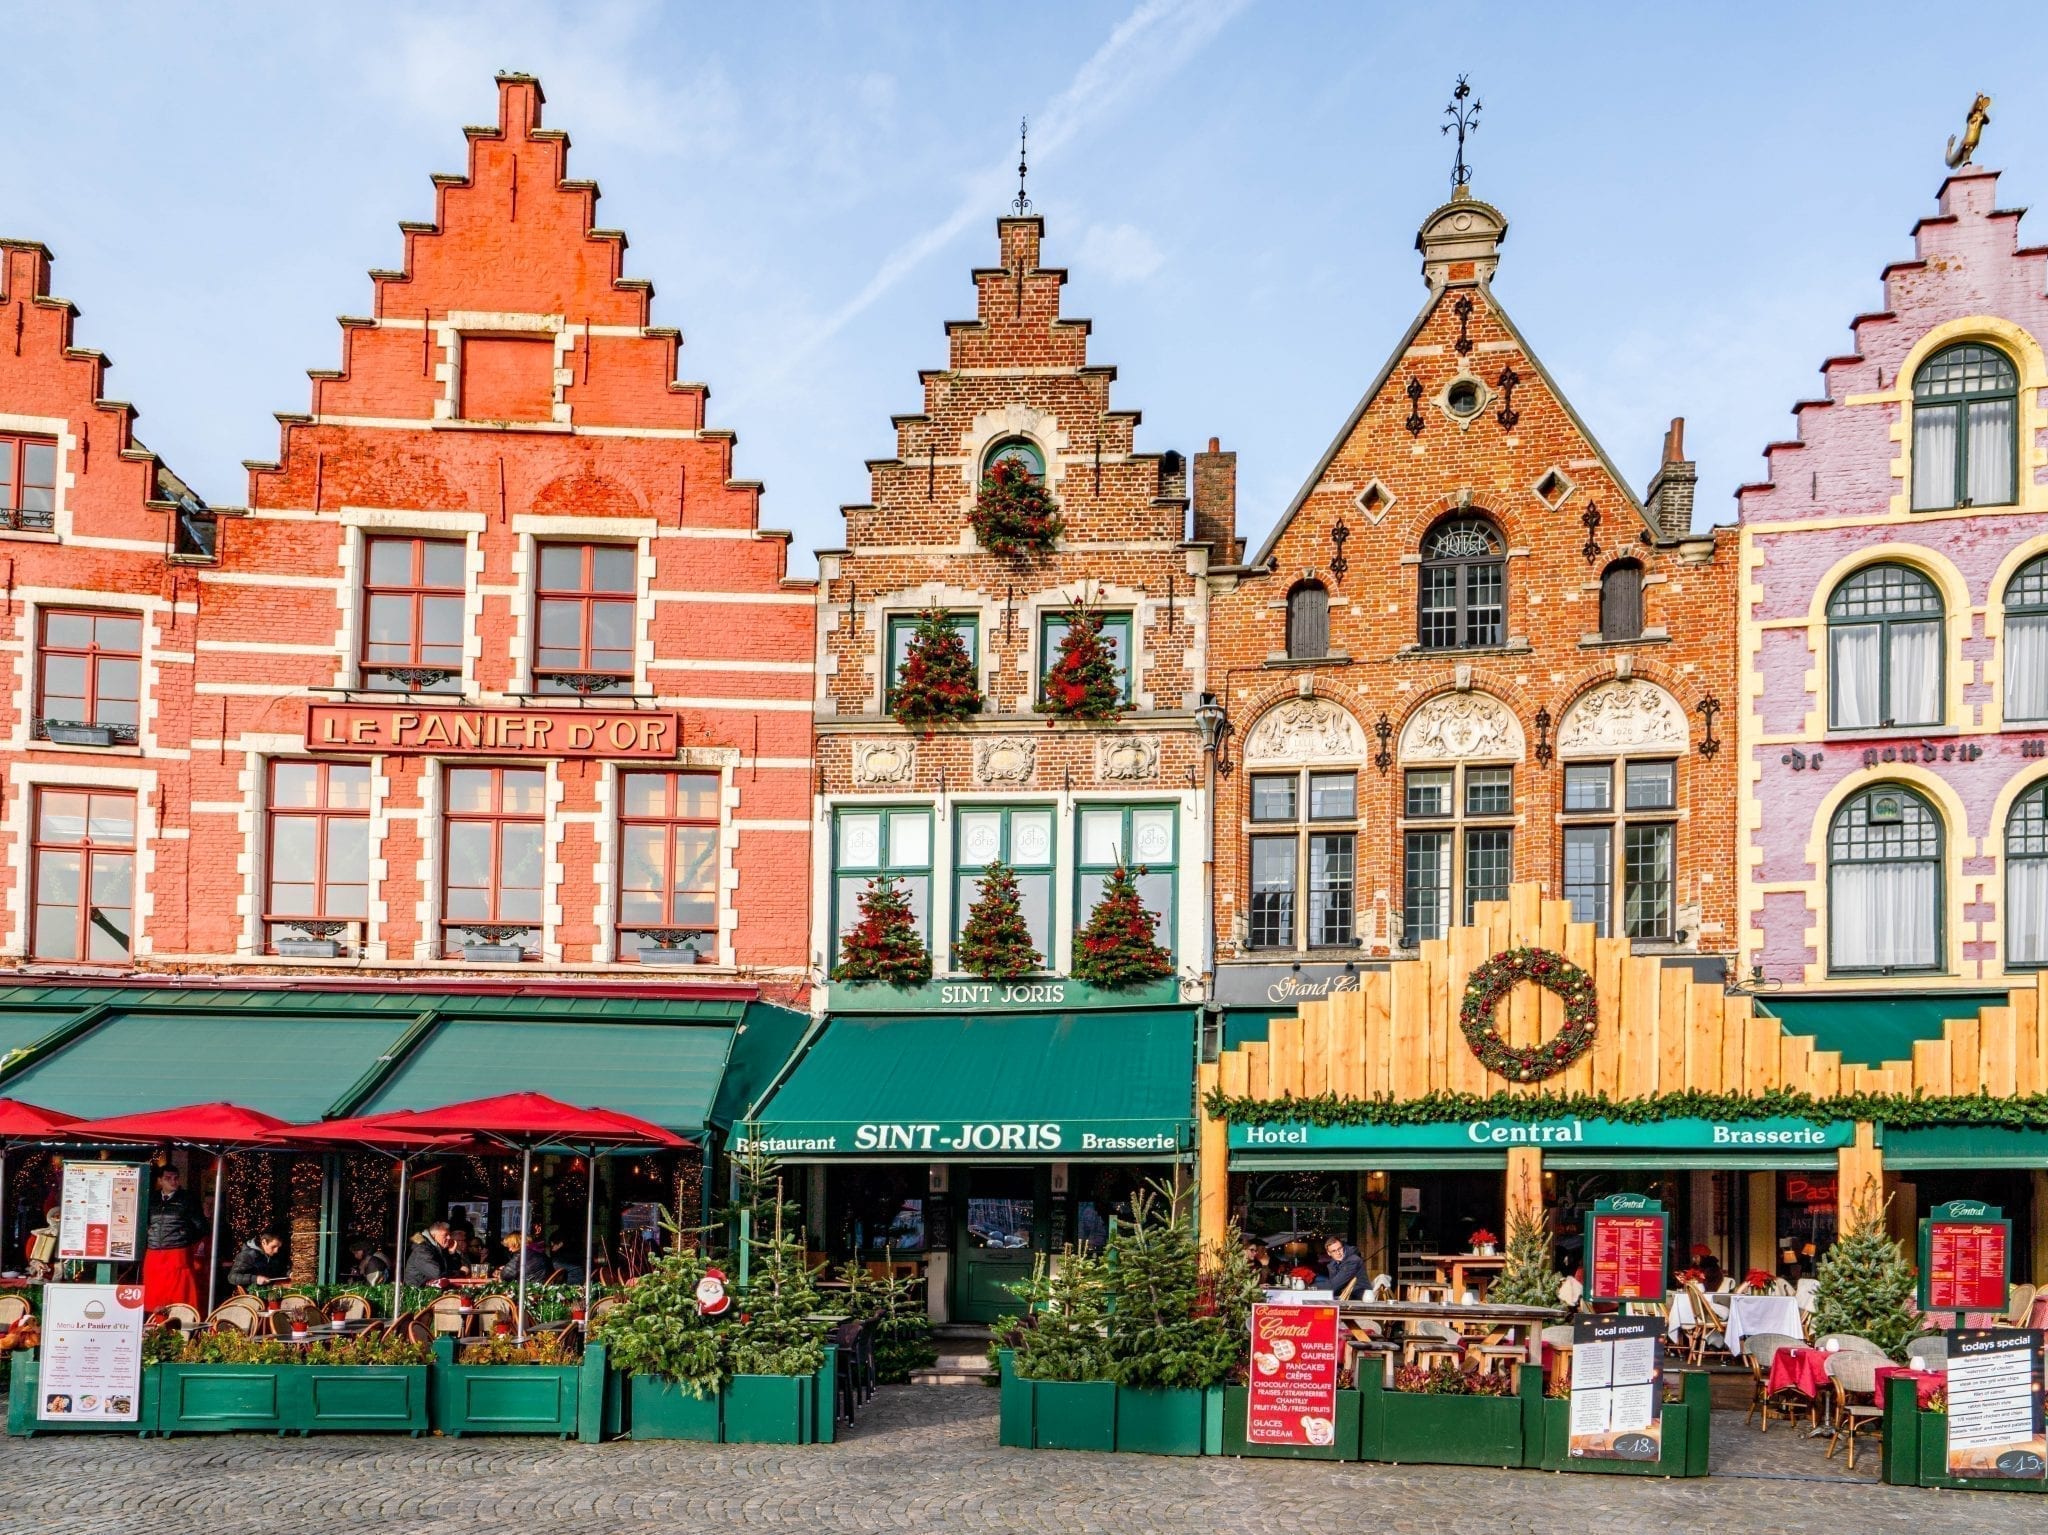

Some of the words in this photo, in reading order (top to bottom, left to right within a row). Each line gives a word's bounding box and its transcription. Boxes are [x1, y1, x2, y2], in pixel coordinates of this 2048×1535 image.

[323, 717, 379, 745] LE
[391, 712, 554, 749] PANIER
[568, 718, 667, 752] D'OR
[1791, 746, 1824, 771] de
[1863, 738, 1976, 770] gouden
[2021, 739, 2045, 758] m
[941, 986, 993, 1004] SINT
[1001, 985, 1065, 1003] JORIS
[1267, 976, 1332, 1003] Grand
[735, 1135, 836, 1153] Restaurant
[853, 1123, 1063, 1151] SINT-JORIS
[1081, 1131, 1176, 1150] Brasserie
[1246, 1126, 1308, 1144] Hotel
[1467, 1120, 1584, 1144] Central
[1712, 1125, 1826, 1145] Brasserie
[1787, 1178, 1839, 1201] Past
[1611, 1196, 1646, 1210] Central
[1949, 1202, 1986, 1218] Central
[87, 1322, 112, 1330] Panier
[1258, 1316, 1313, 1340] Central
[1594, 1326, 1617, 1336] local
[1618, 1325, 1645, 1334] menu
[1301, 1342, 1334, 1351] WAFFLES
[1961, 1341, 1995, 1352] todays
[1997, 1335, 2031, 1349] special
[1301, 1352, 1335, 1361] GAUFRES
[1285, 1363, 1326, 1371] PANCAKES
[1285, 1370, 1313, 1381] CRÊPES
[1253, 1381, 1289, 1389] CHOCOLAT
[1293, 1382, 1332, 1390] CHOCOLATE
[1257, 1389, 1281, 1397] FRAISES
[1275, 1397, 1309, 1405] CHANTILLY
[1292, 1405, 1310, 1413] FRESH
[1310, 1405, 1331, 1413] FRUITS
[1253, 1419, 1283, 1428] GLACES
[1253, 1429, 1266, 1437] ICE
[1266, 1429, 1293, 1438] CREAM
